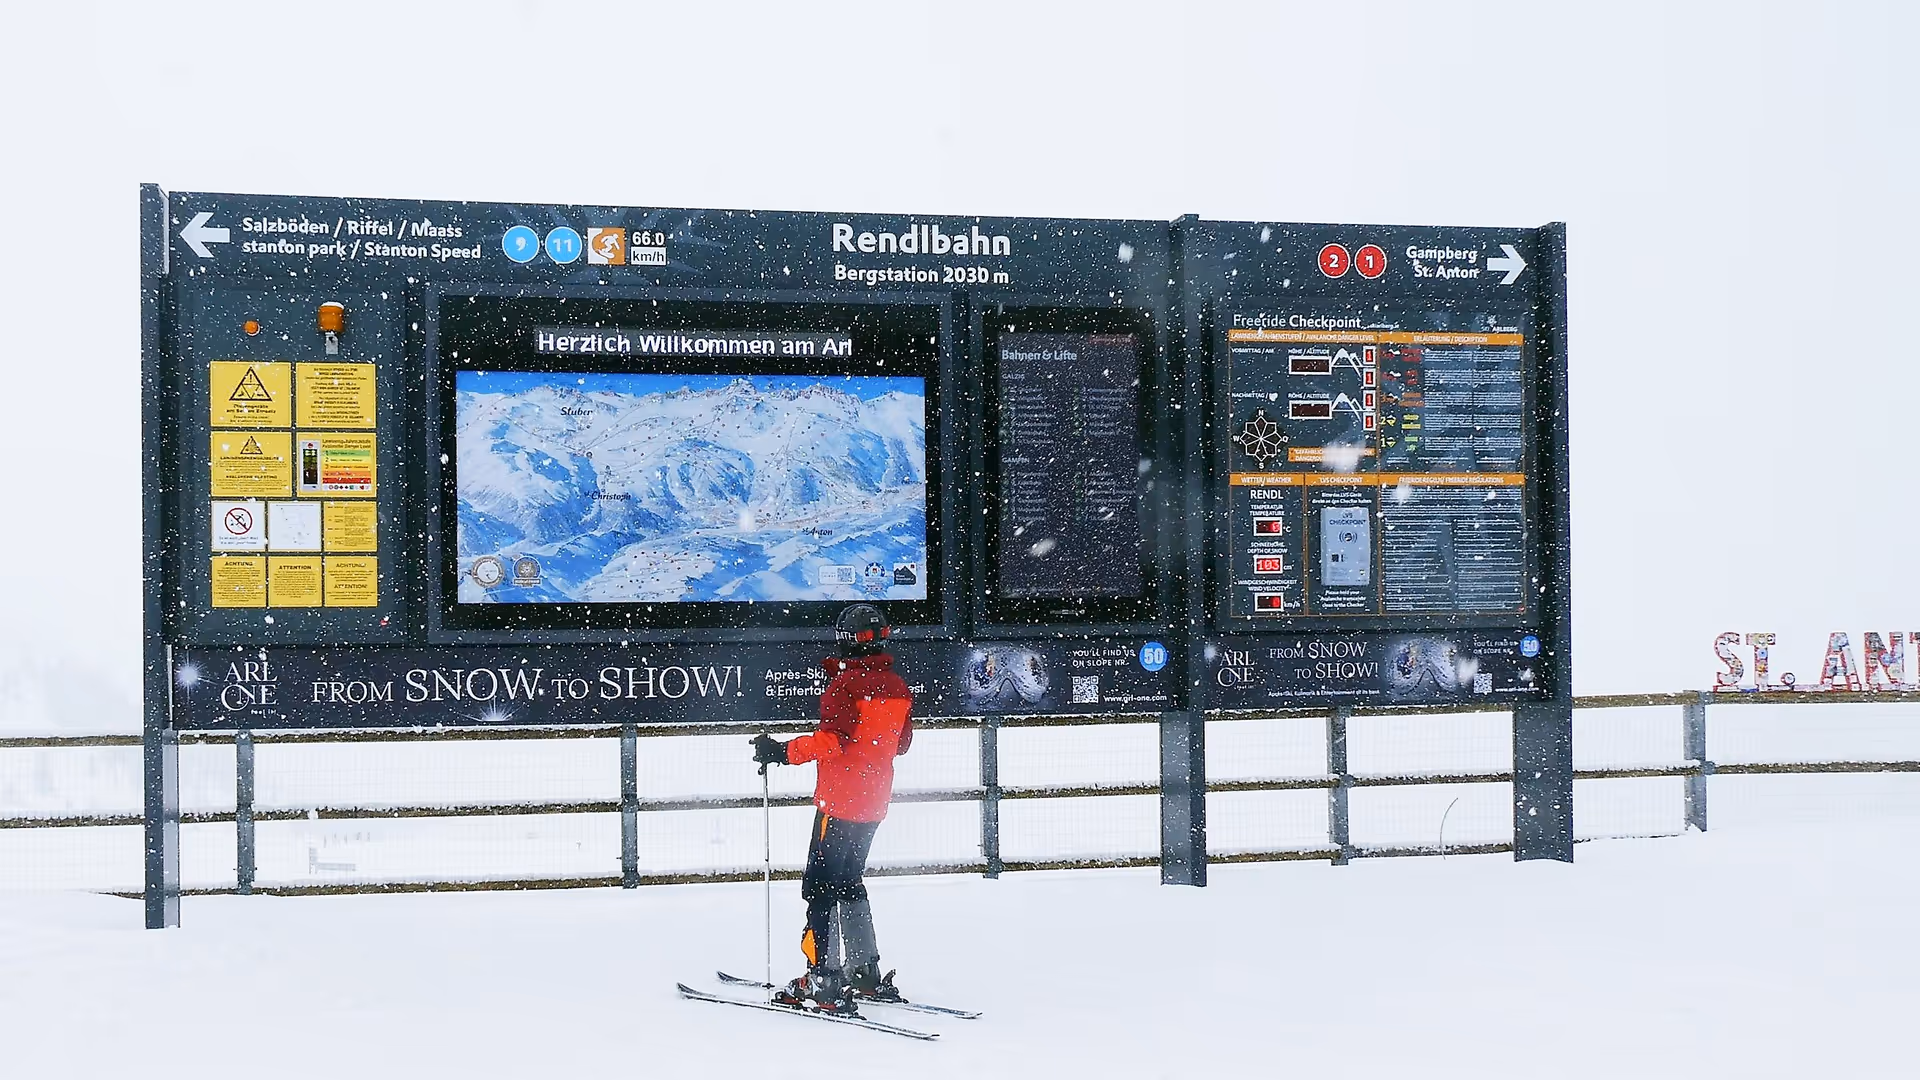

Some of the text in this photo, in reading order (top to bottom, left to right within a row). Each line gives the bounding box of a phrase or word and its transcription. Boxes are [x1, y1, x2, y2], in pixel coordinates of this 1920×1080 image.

[242, 217, 329, 234] Salzböden
[347, 220, 393, 236] Riffel
[412, 222, 462, 238] Maass
[552, 238, 572, 252] 11
[632, 232, 665, 246] 66.0
[832, 223, 1011, 256] Rendlbahn
[243, 240, 304, 255] stanton
[309, 241, 346, 258] park
[364, 243, 428, 258] Stanton
[431, 244, 481, 261] Speed
[632, 250, 664, 262] km/h
[1406, 246, 1478, 262] Gampberg
[1329, 254, 1339, 268] 2
[1365, 255, 1374, 268] 1
[834, 264, 1010, 286] Bergstation 2030 m
[1414, 264, 1479, 279] St. Anton
[1234, 314, 1361, 331] Freeride Checkpoint
[538, 333, 630, 352] Herzlich
[639, 335, 776, 354] Willkommen
[782, 340, 814, 356] am
[1002, 350, 1078, 362] Bahnen & Lifte
[1250, 490, 1284, 500] RENDL
[1257, 559, 1280, 570] 103
[1270, 641, 1367, 659] FROM SNOW
[1523, 640, 1538, 652] 50
[1144, 648, 1164, 664] 50
[1220, 650, 1255, 666] ARL
[224, 661, 278, 682] ARL
[765, 668, 828, 683] Après-Ski,
[1217, 667, 1254, 688] ONE
[1294, 662, 1378, 680] TO SHOW!
[312, 665, 743, 703] FROM SNOW TO SHOW!
[765, 685, 928, 697] & Entertai est.
[221, 684, 278, 711] ONE
